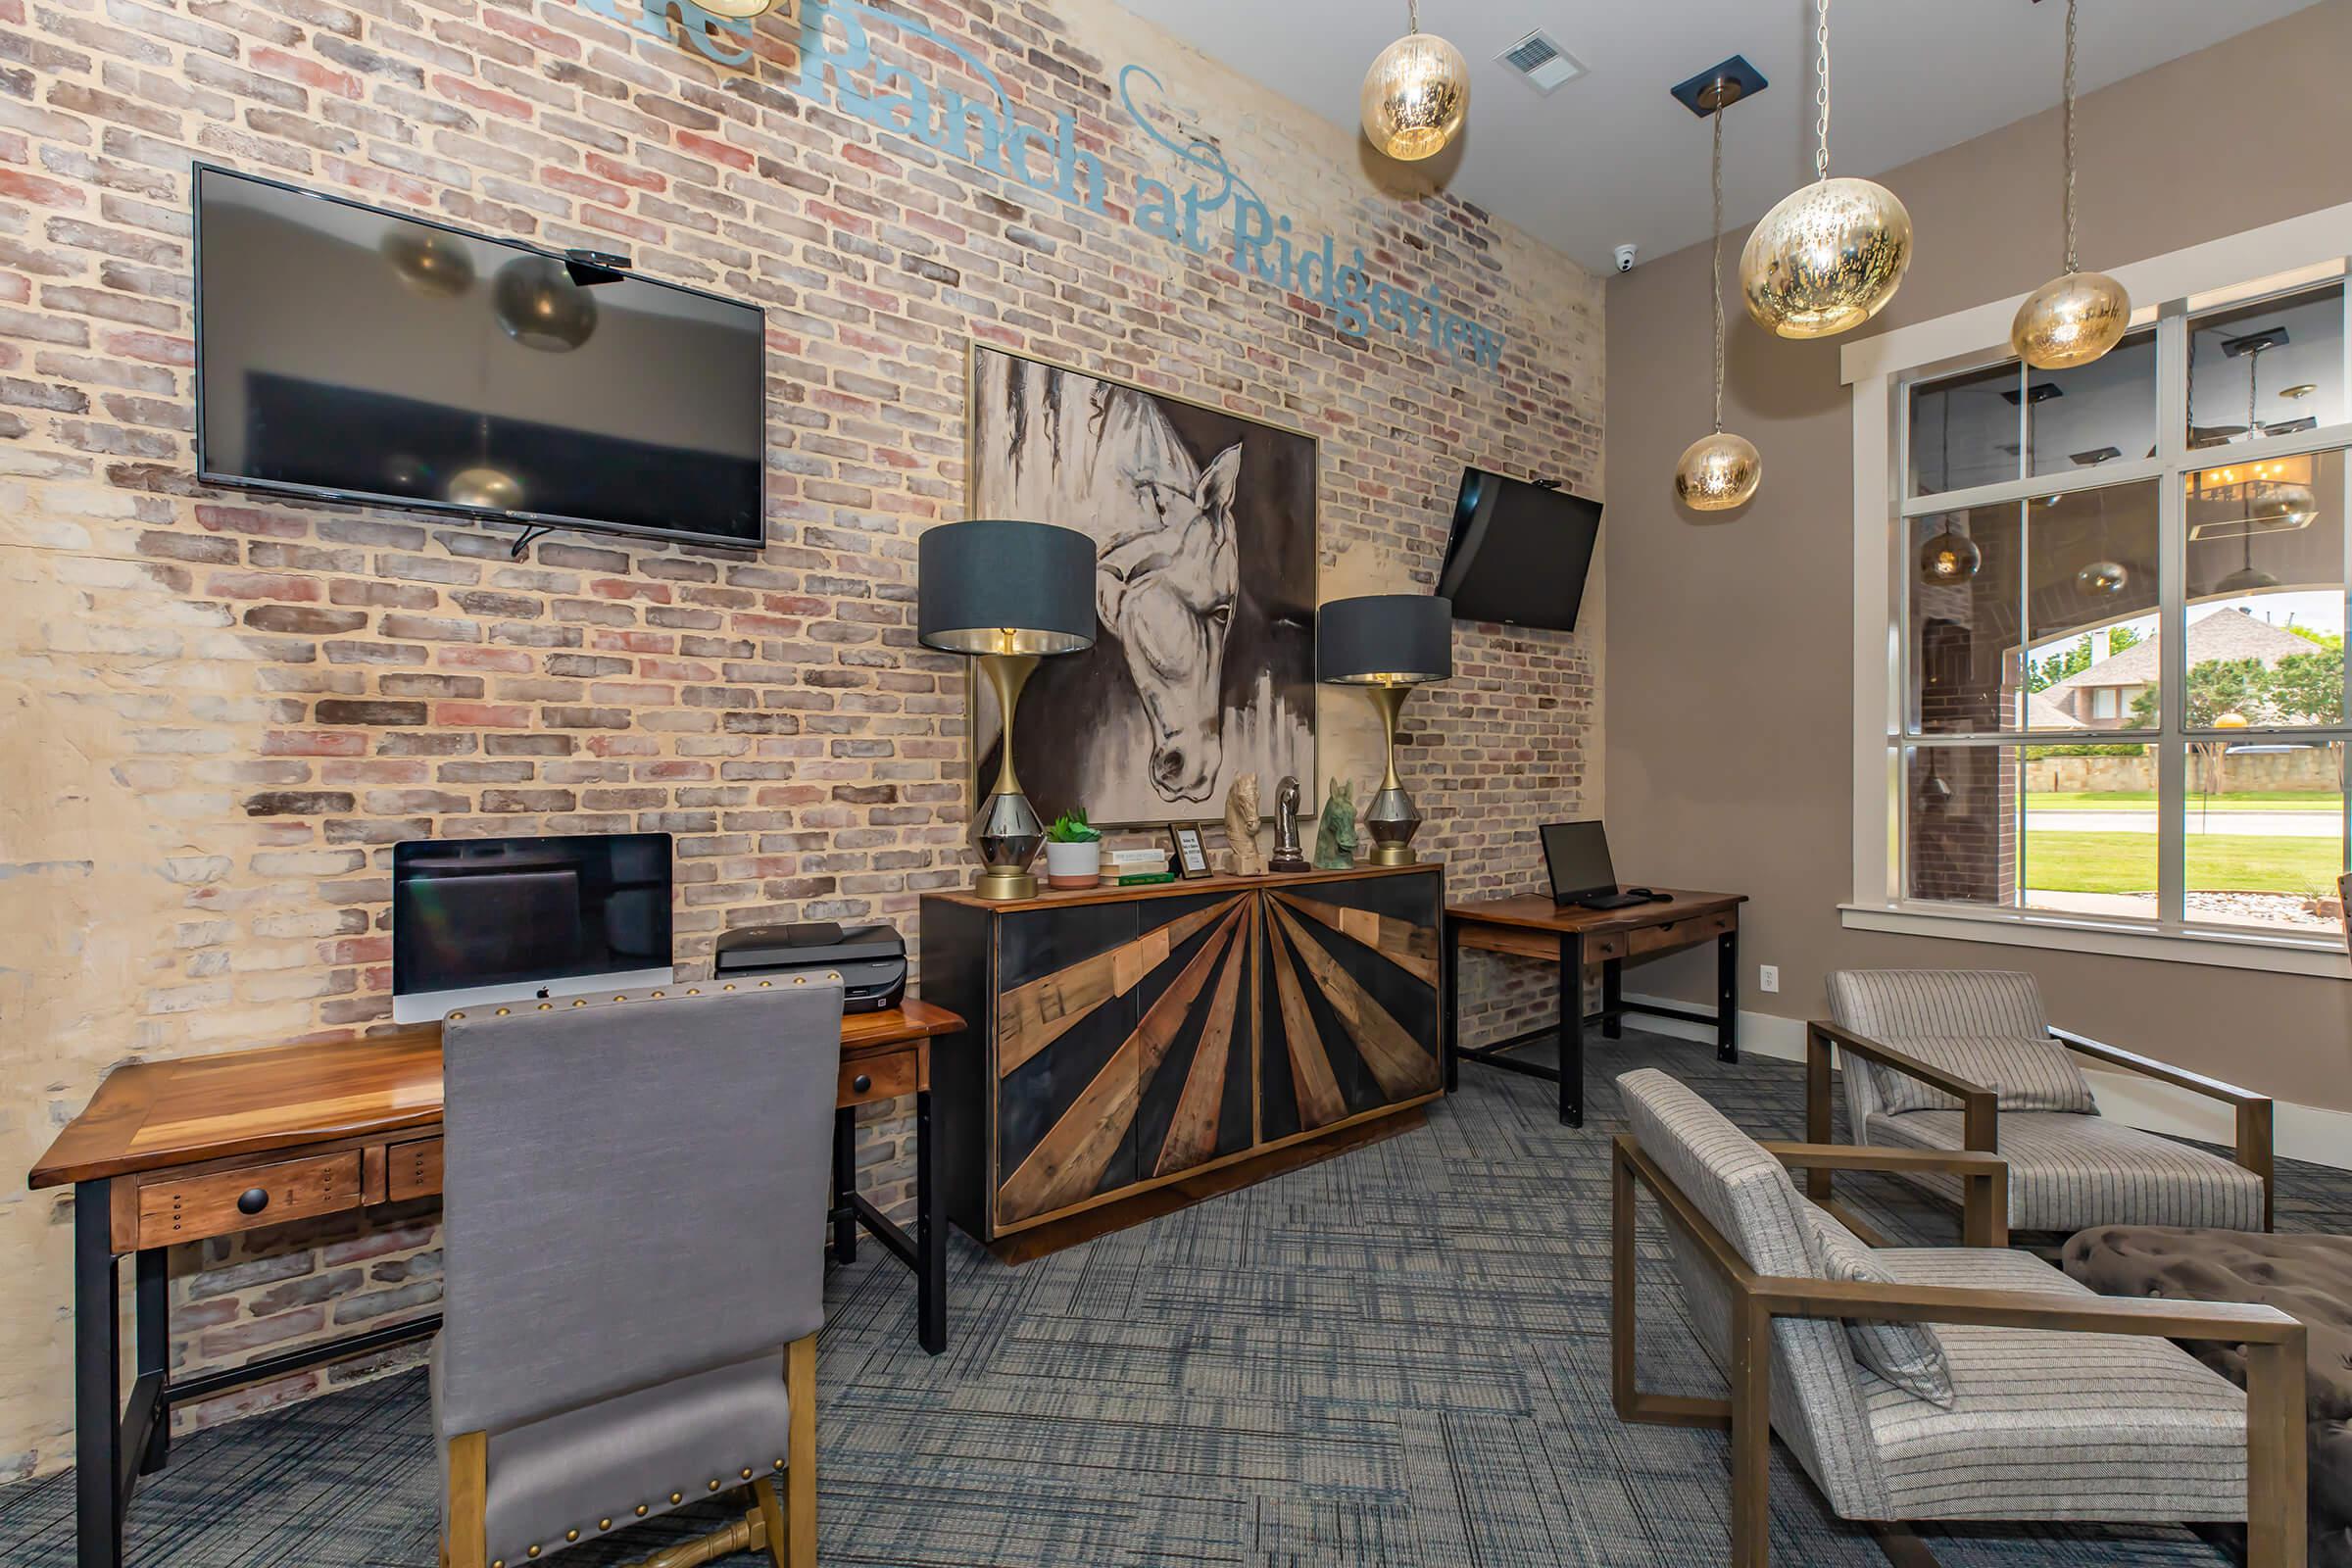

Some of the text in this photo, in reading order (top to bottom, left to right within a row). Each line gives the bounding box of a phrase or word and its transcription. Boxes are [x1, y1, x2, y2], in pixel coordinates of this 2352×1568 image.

[789, 0, 1506, 372] Ranch at Ridgeview
